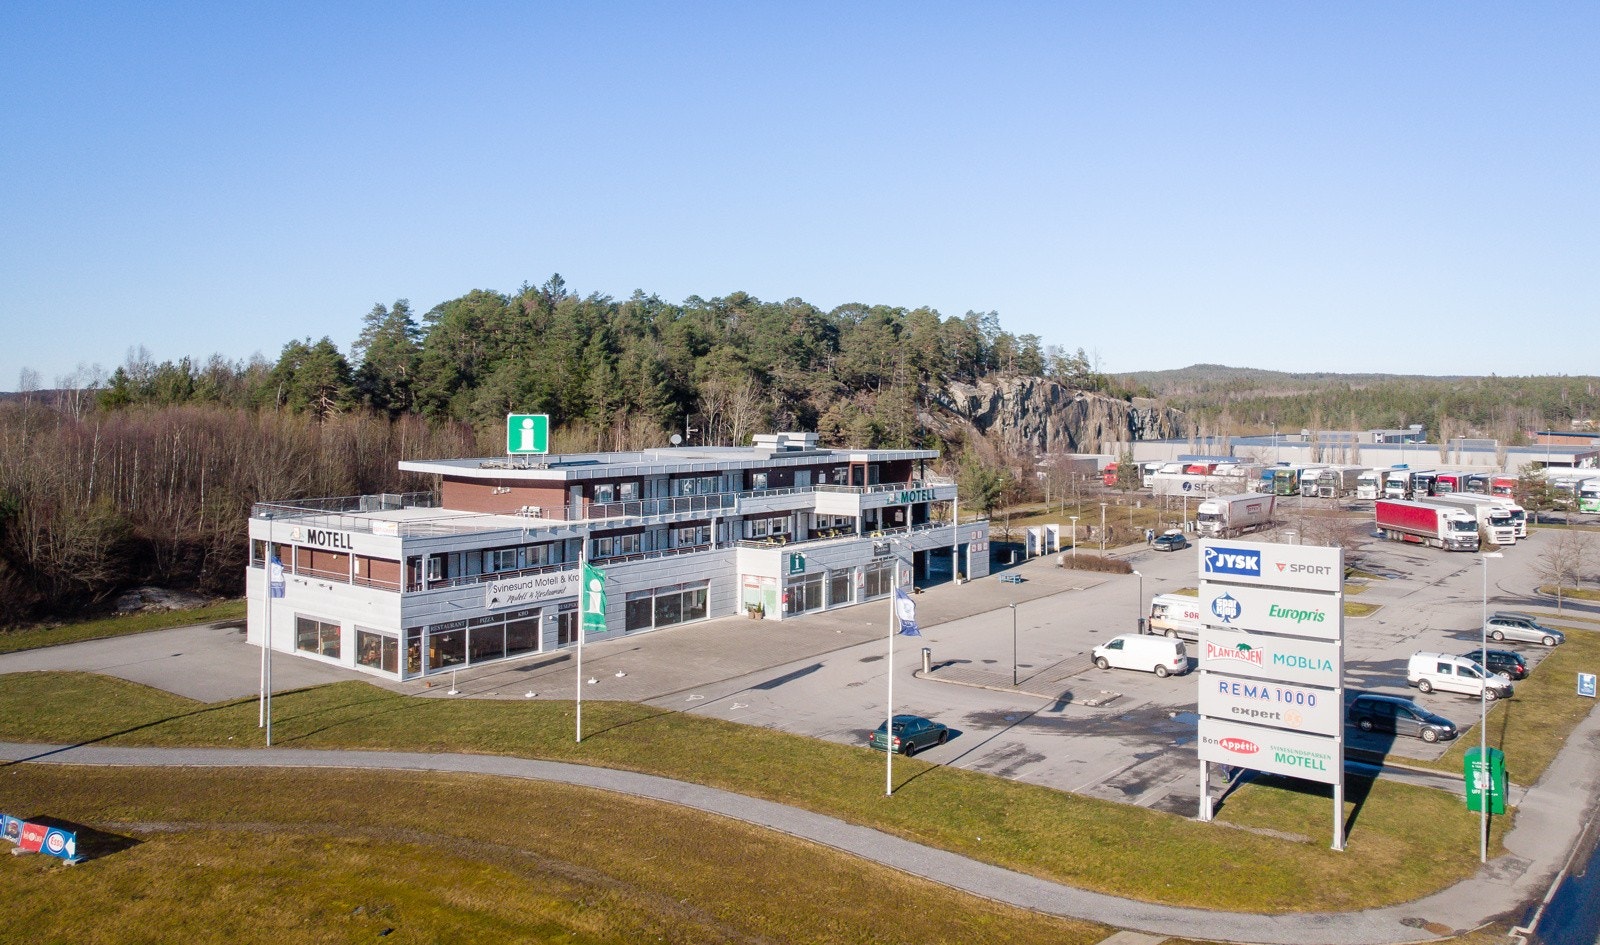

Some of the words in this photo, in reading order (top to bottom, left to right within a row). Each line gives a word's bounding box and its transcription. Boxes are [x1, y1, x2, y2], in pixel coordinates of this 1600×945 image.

[901, 489, 937, 504] MOTELL
[307, 528, 354, 550] MOTELL
[1215, 553, 1259, 571] JYSK
[1290, 563, 1332, 576] SPORT
[493, 581, 533, 594] Svinesund
[535, 575, 559, 587] Motell
[560, 575, 566, 583] &
[1268, 604, 1326, 624] Europris
[430, 621, 466, 632] RESTAURANT
[1207, 643, 1262, 665] PLANTASJEN
[1273, 653, 1333, 672] MØBLIA
[1219, 681, 1270, 700] REMA
[1276, 689, 1317, 707] 1000
[1231, 706, 1281, 720] expert
[1202, 736, 1219, 745] Bon
[1222, 740, 1257, 752] Appétit
[1275, 752, 1327, 771] MOTELL
